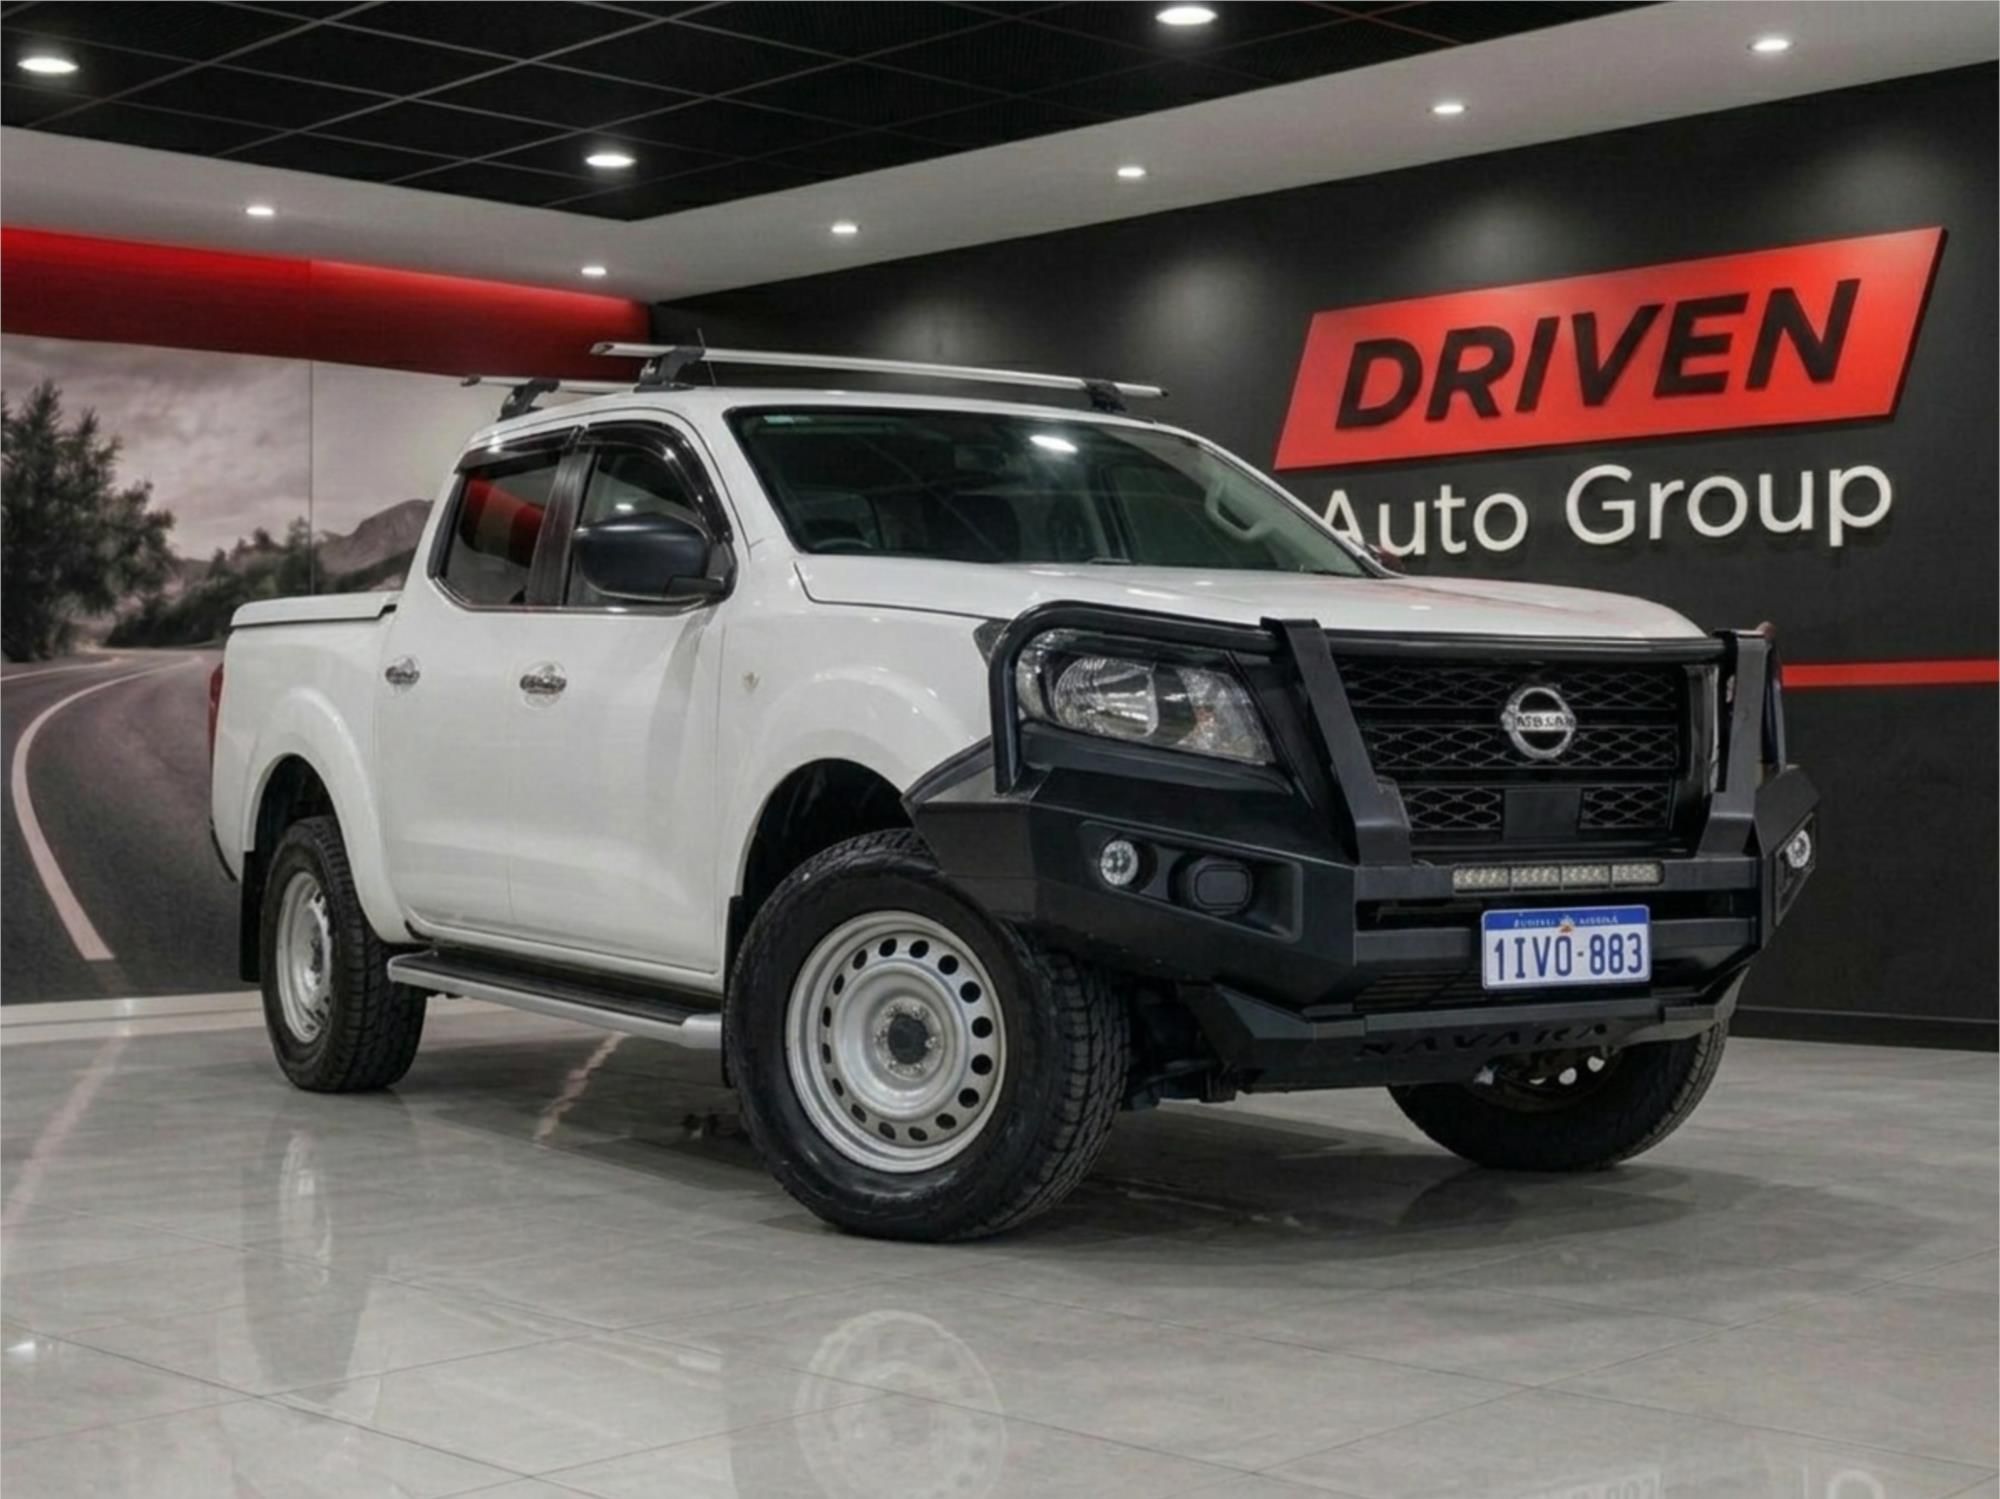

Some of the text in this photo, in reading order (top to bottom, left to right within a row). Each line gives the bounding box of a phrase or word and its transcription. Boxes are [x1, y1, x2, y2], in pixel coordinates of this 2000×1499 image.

[1335, 278, 1861, 431] DRIVEN
[1322, 463, 1892, 557] Auto Group
[1494, 932, 1643, 981] 1IVO-883
